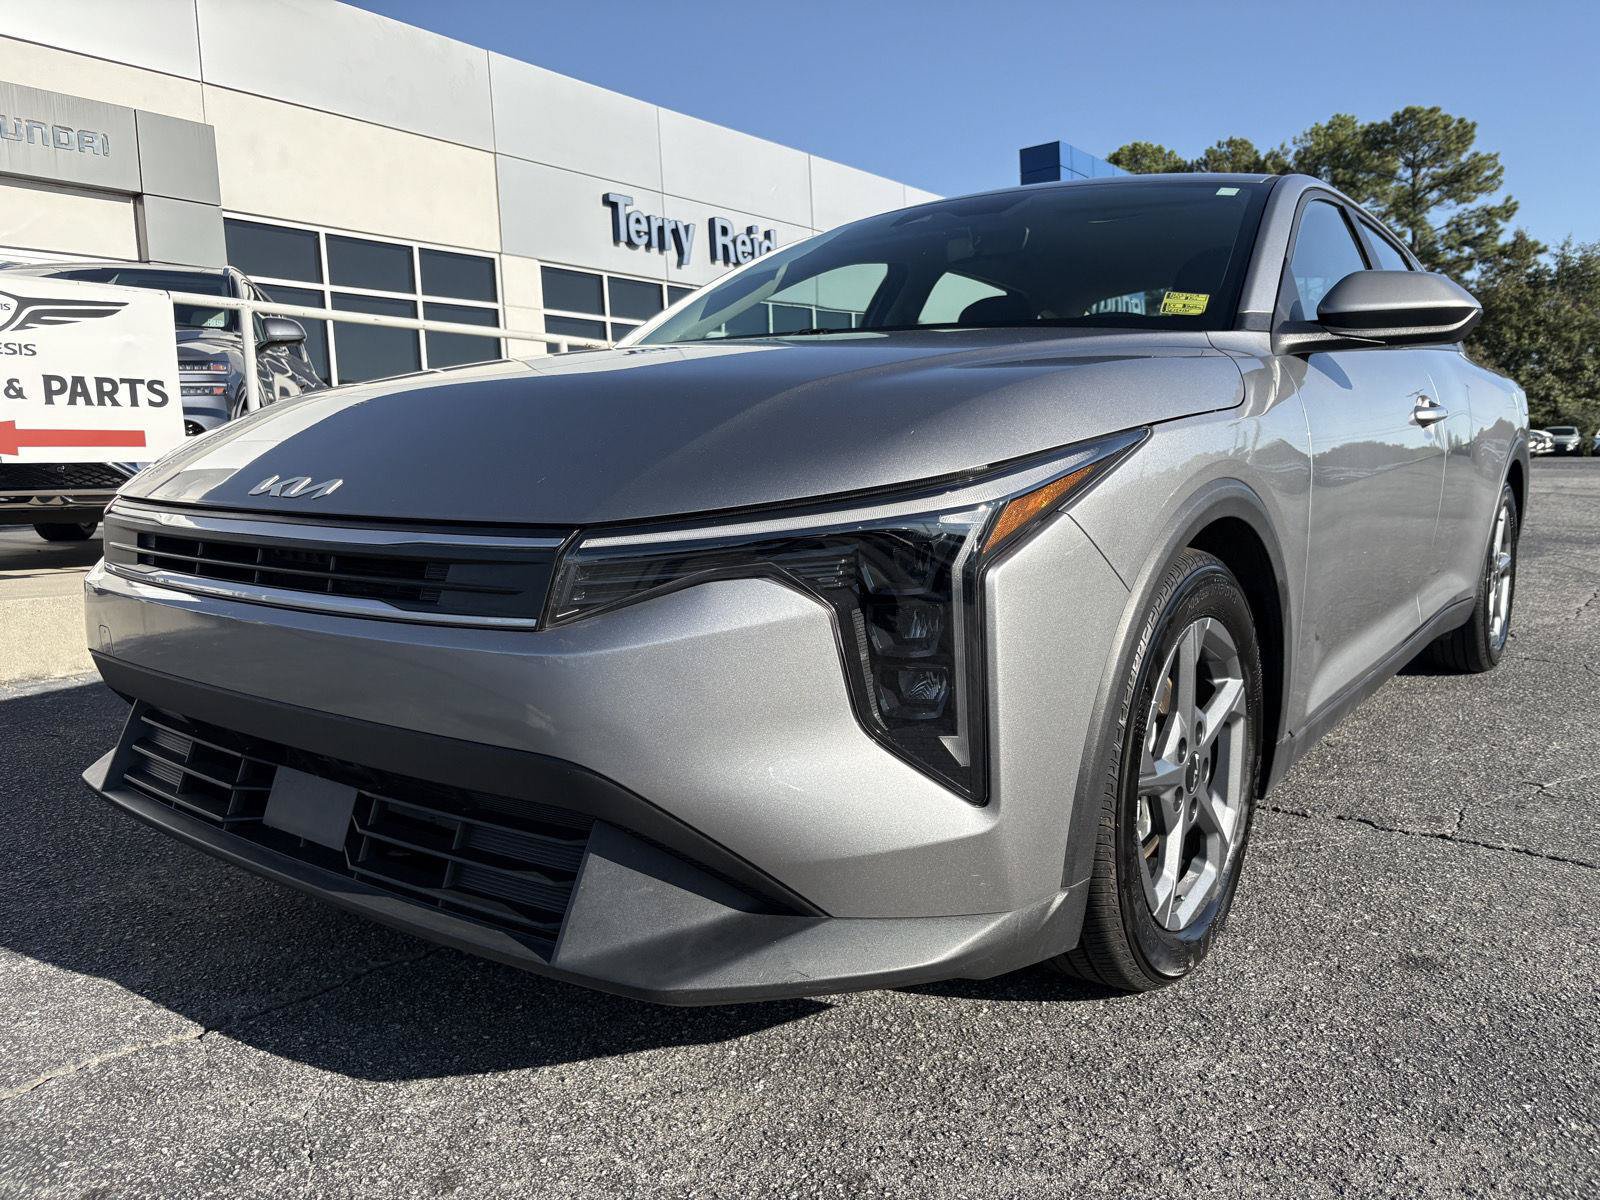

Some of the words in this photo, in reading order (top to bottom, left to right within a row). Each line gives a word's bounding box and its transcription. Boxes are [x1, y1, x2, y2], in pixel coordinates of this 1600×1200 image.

[602, 192, 696, 270] Terry
[3, 378, 28, 400] &
[42, 374, 169, 408] PARTS
[247, 475, 344, 500] KIA
